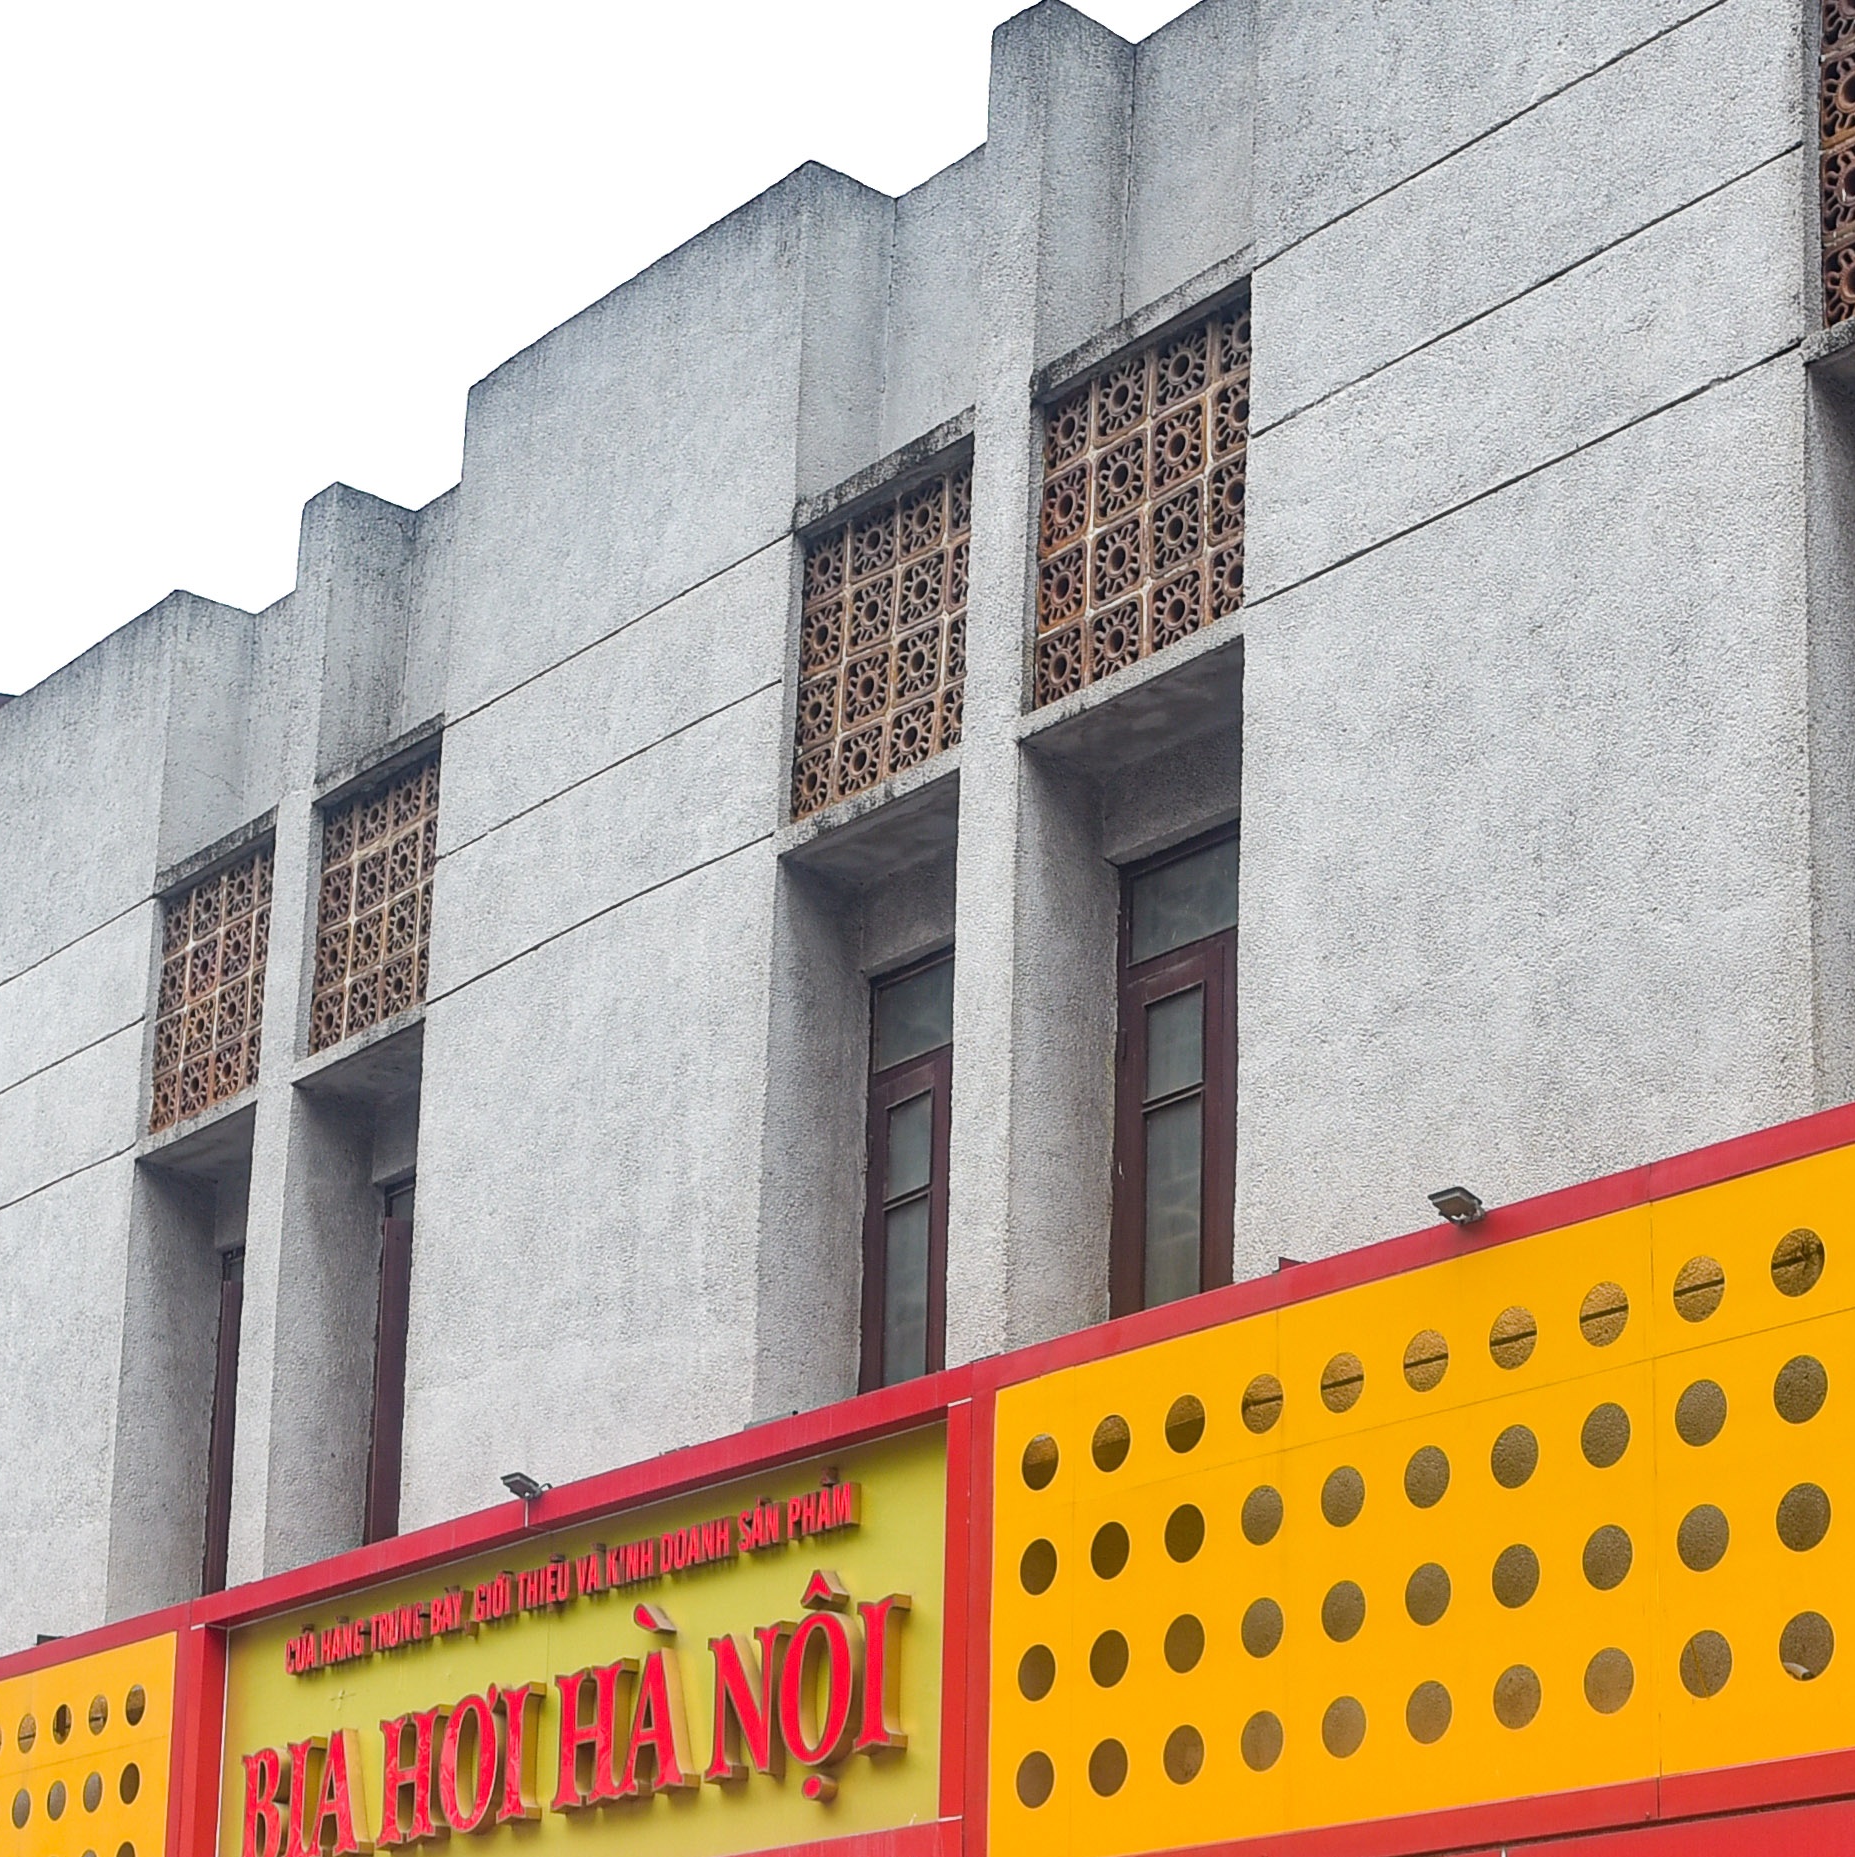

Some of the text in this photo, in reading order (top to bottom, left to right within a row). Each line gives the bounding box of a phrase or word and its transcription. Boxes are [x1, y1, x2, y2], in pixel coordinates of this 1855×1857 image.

[321, 1616, 364, 1665] HÀNG
[370, 1601, 423, 1651] TRƯNG
[474, 1571, 512, 1623] GIỚI
[517, 1555, 570, 1612] THIỆU
[576, 1543, 604, 1594] VÀ
[660, 1517, 730, 1573] DOANH
[376, 1681, 538, 1850] HƠI
[551, 1603, 690, 1812] HÀ
[706, 1569, 904, 1800] NỘI
